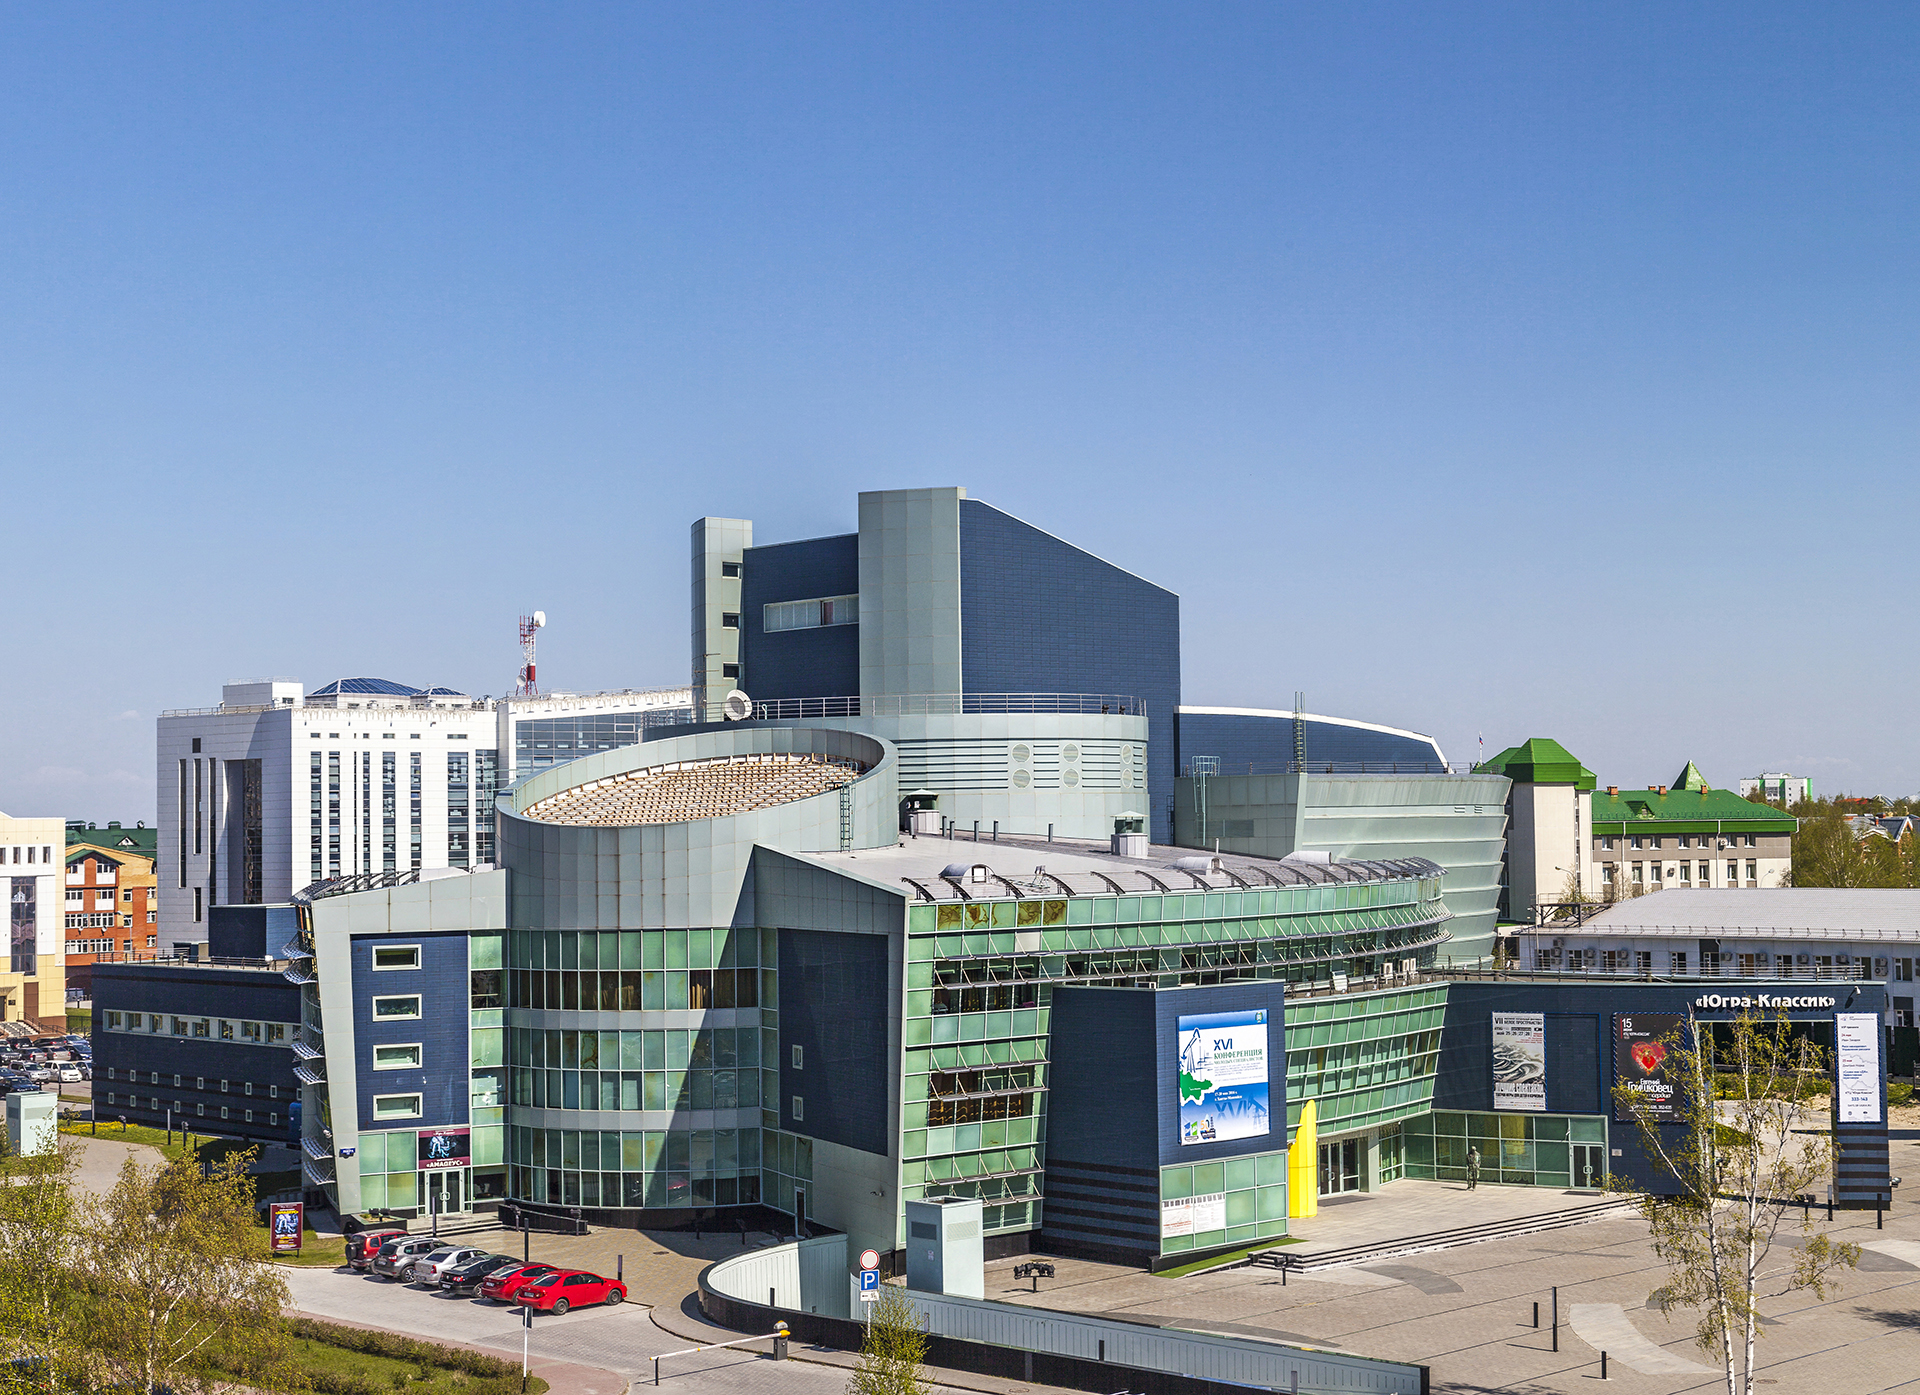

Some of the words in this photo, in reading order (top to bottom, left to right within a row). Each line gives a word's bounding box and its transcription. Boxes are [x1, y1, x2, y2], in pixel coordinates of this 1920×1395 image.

[1695, 994, 1836, 1008] «Югра-Классик»
[1622, 1018, 1632, 1028] 15
[1214, 1038, 1232, 1051] XVI
[1214, 1049, 1262, 1060] КОНФЕРЕНЦИЯ
[1628, 1082, 1673, 1094] Гришковец
[426, 1160, 463, 1168] «АМАДЕУС»
[864, 1273, 875, 1289] P
